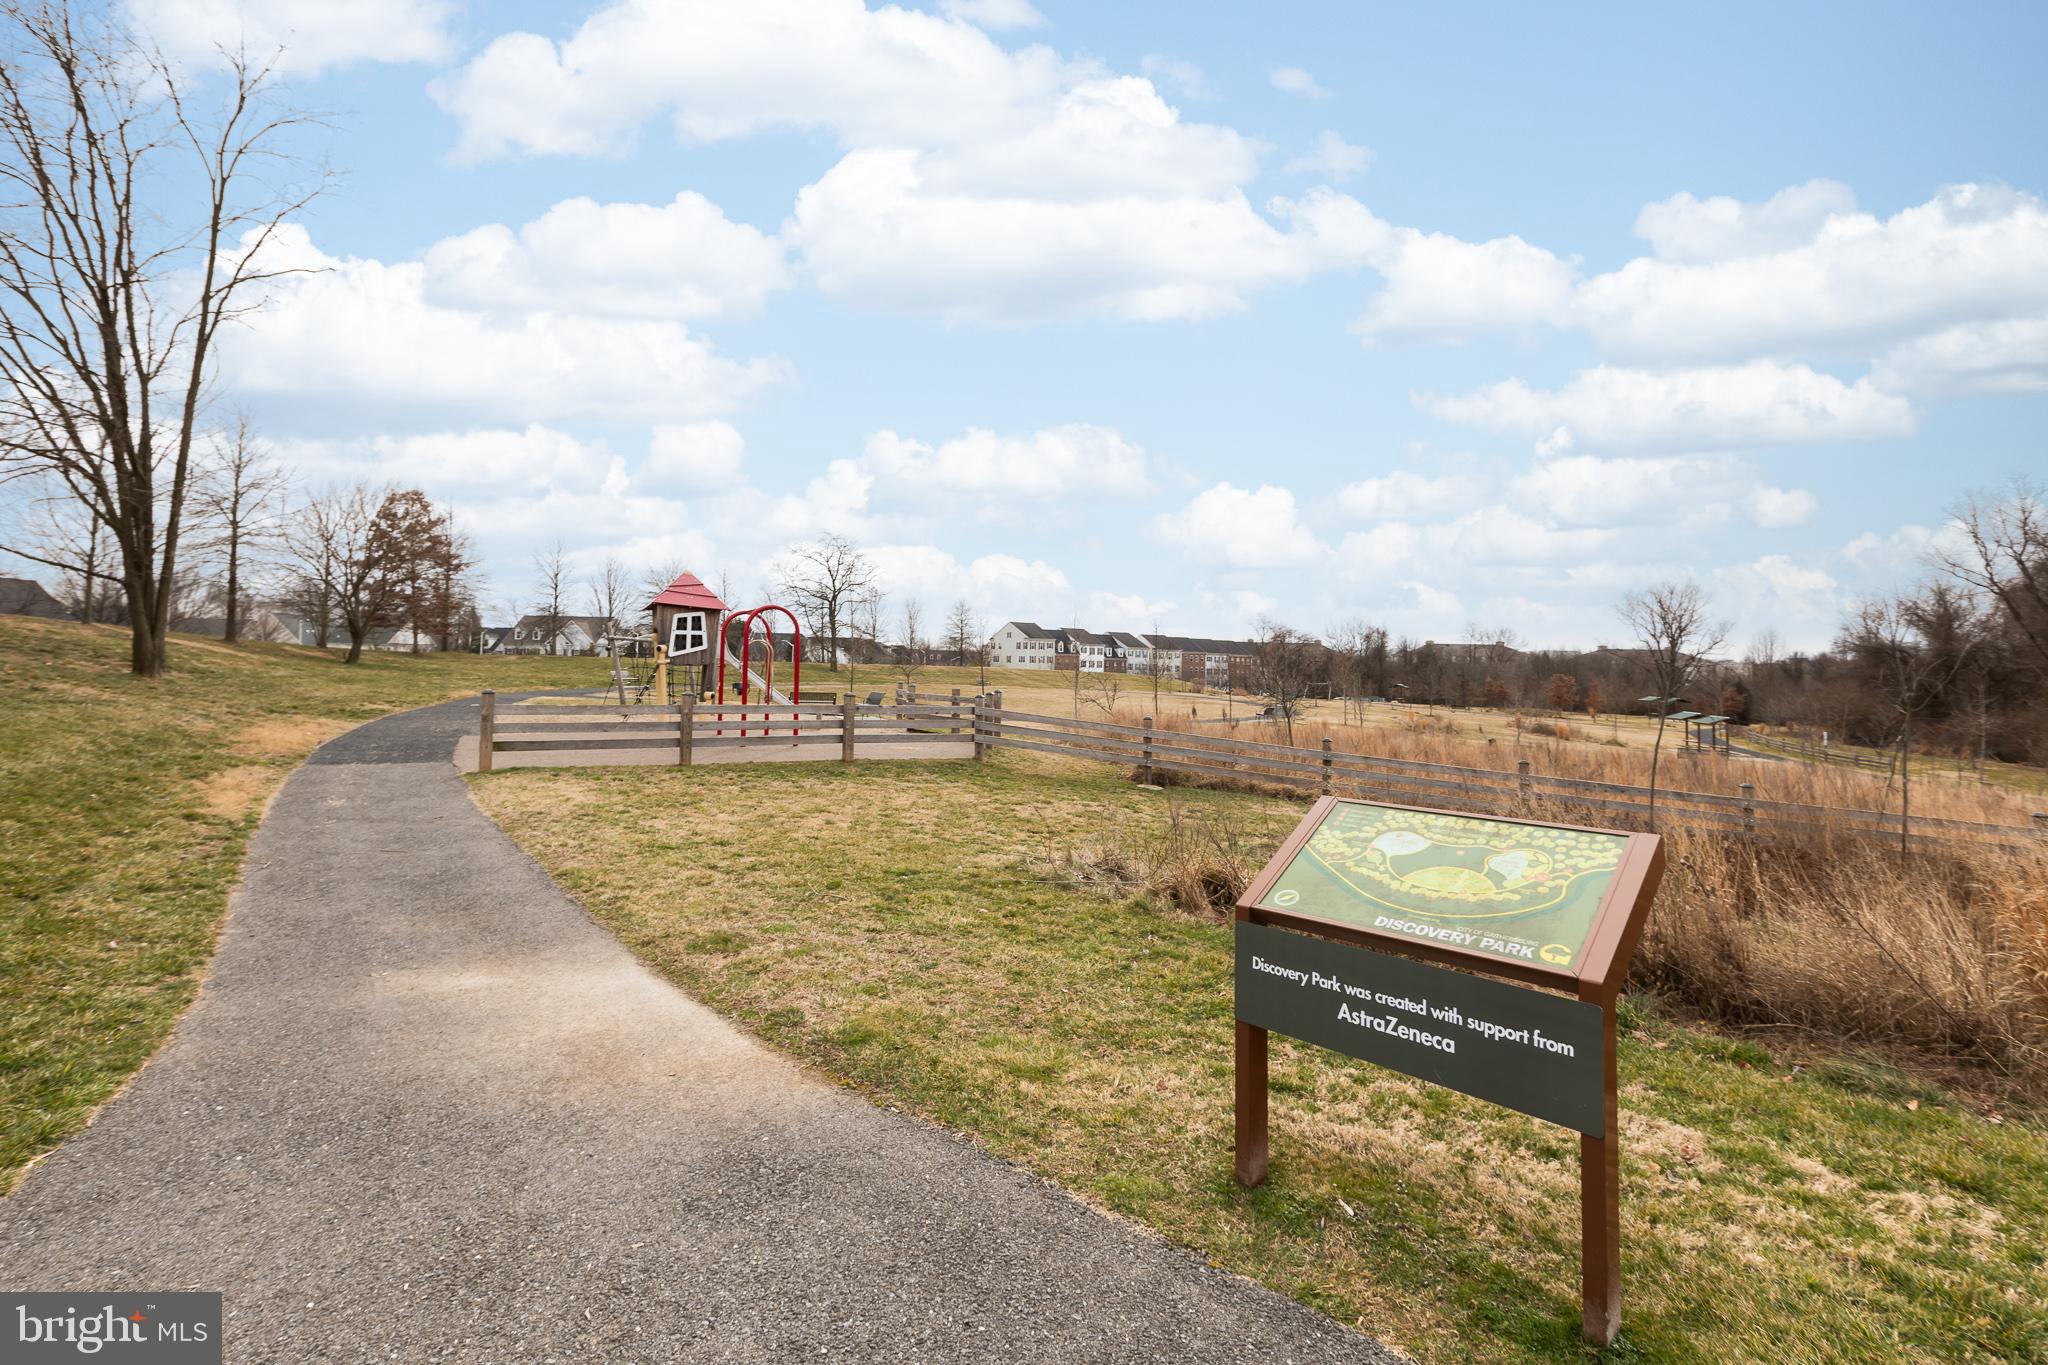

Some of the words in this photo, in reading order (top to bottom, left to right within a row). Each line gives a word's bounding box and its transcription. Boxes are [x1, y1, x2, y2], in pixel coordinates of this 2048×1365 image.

[1374, 915, 1478, 945] DISCOVERY
[1479, 937, 1536, 959] PARK
[1252, 956, 1309, 986] Discovery
[1311, 972, 1341, 993] Park
[1344, 984, 1372, 1000] was
[1375, 992, 1427, 1016] created
[1430, 1006, 1463, 1026] with
[1467, 1017, 1530, 1041] support
[1533, 1029, 1575, 1057] from
[1337, 1003, 1456, 1054] AstraZeneca
